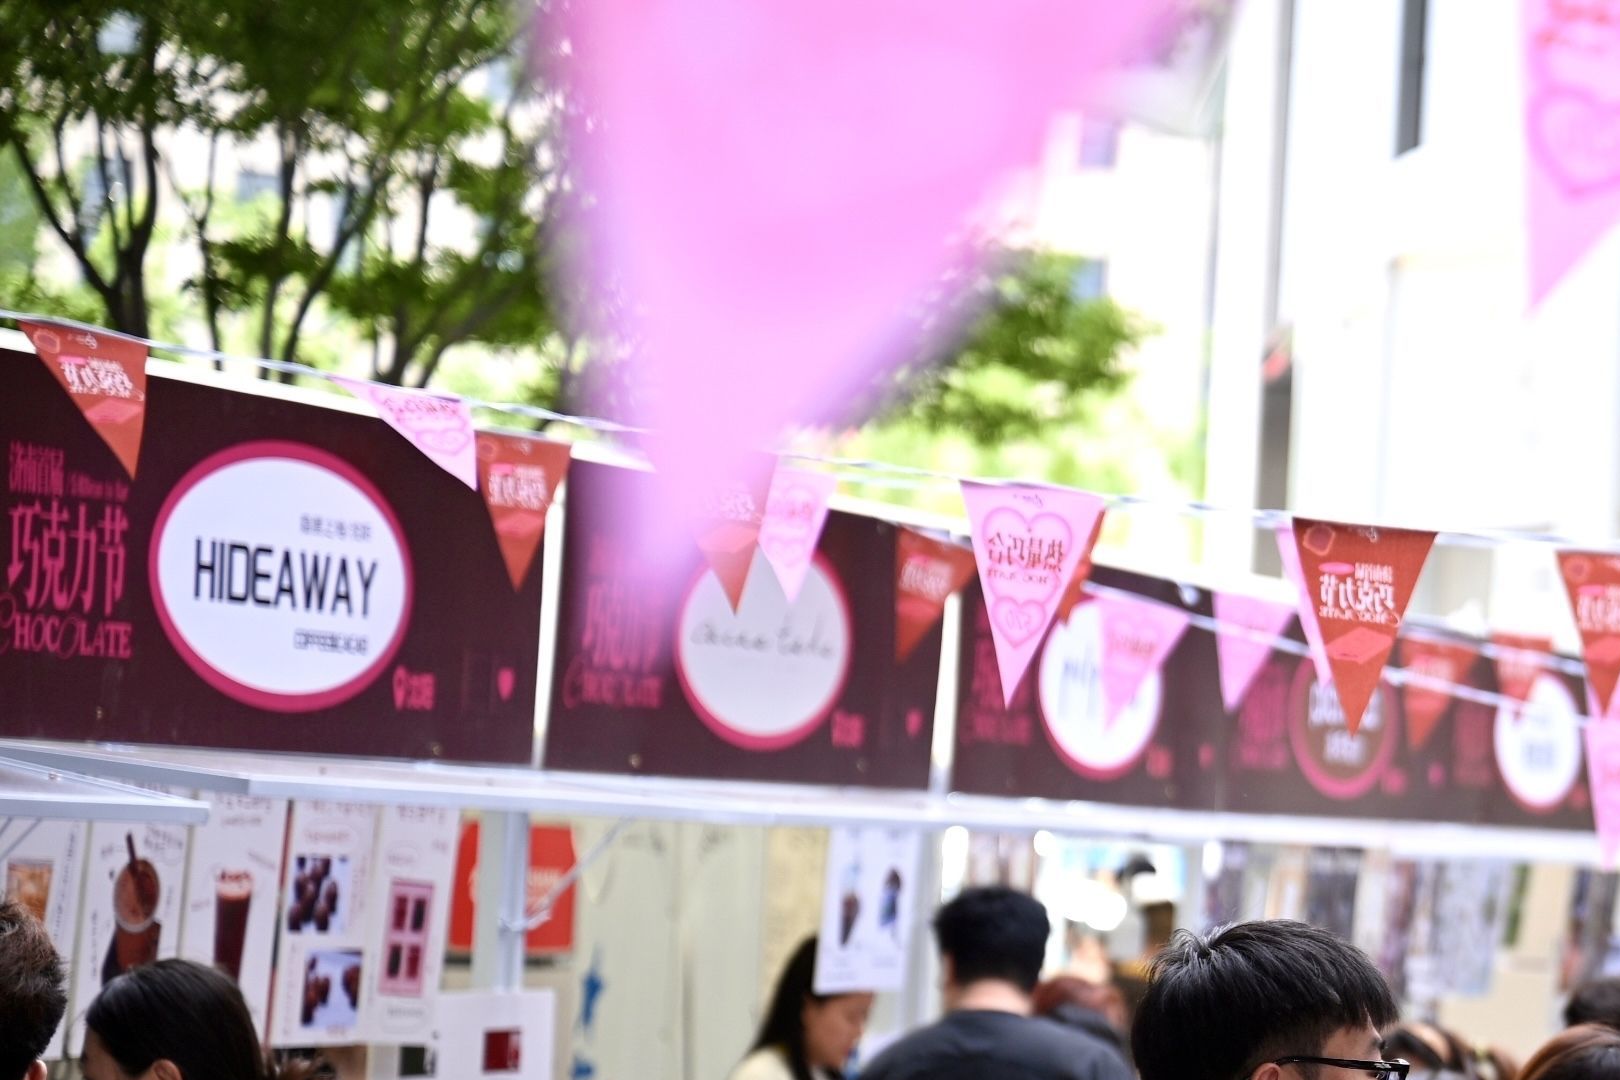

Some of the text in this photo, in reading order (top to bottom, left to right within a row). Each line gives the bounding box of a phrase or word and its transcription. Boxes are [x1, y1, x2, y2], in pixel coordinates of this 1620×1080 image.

[8, 500, 129, 617] 巧克力节
[193, 536, 378, 618] HIDEAWAY
